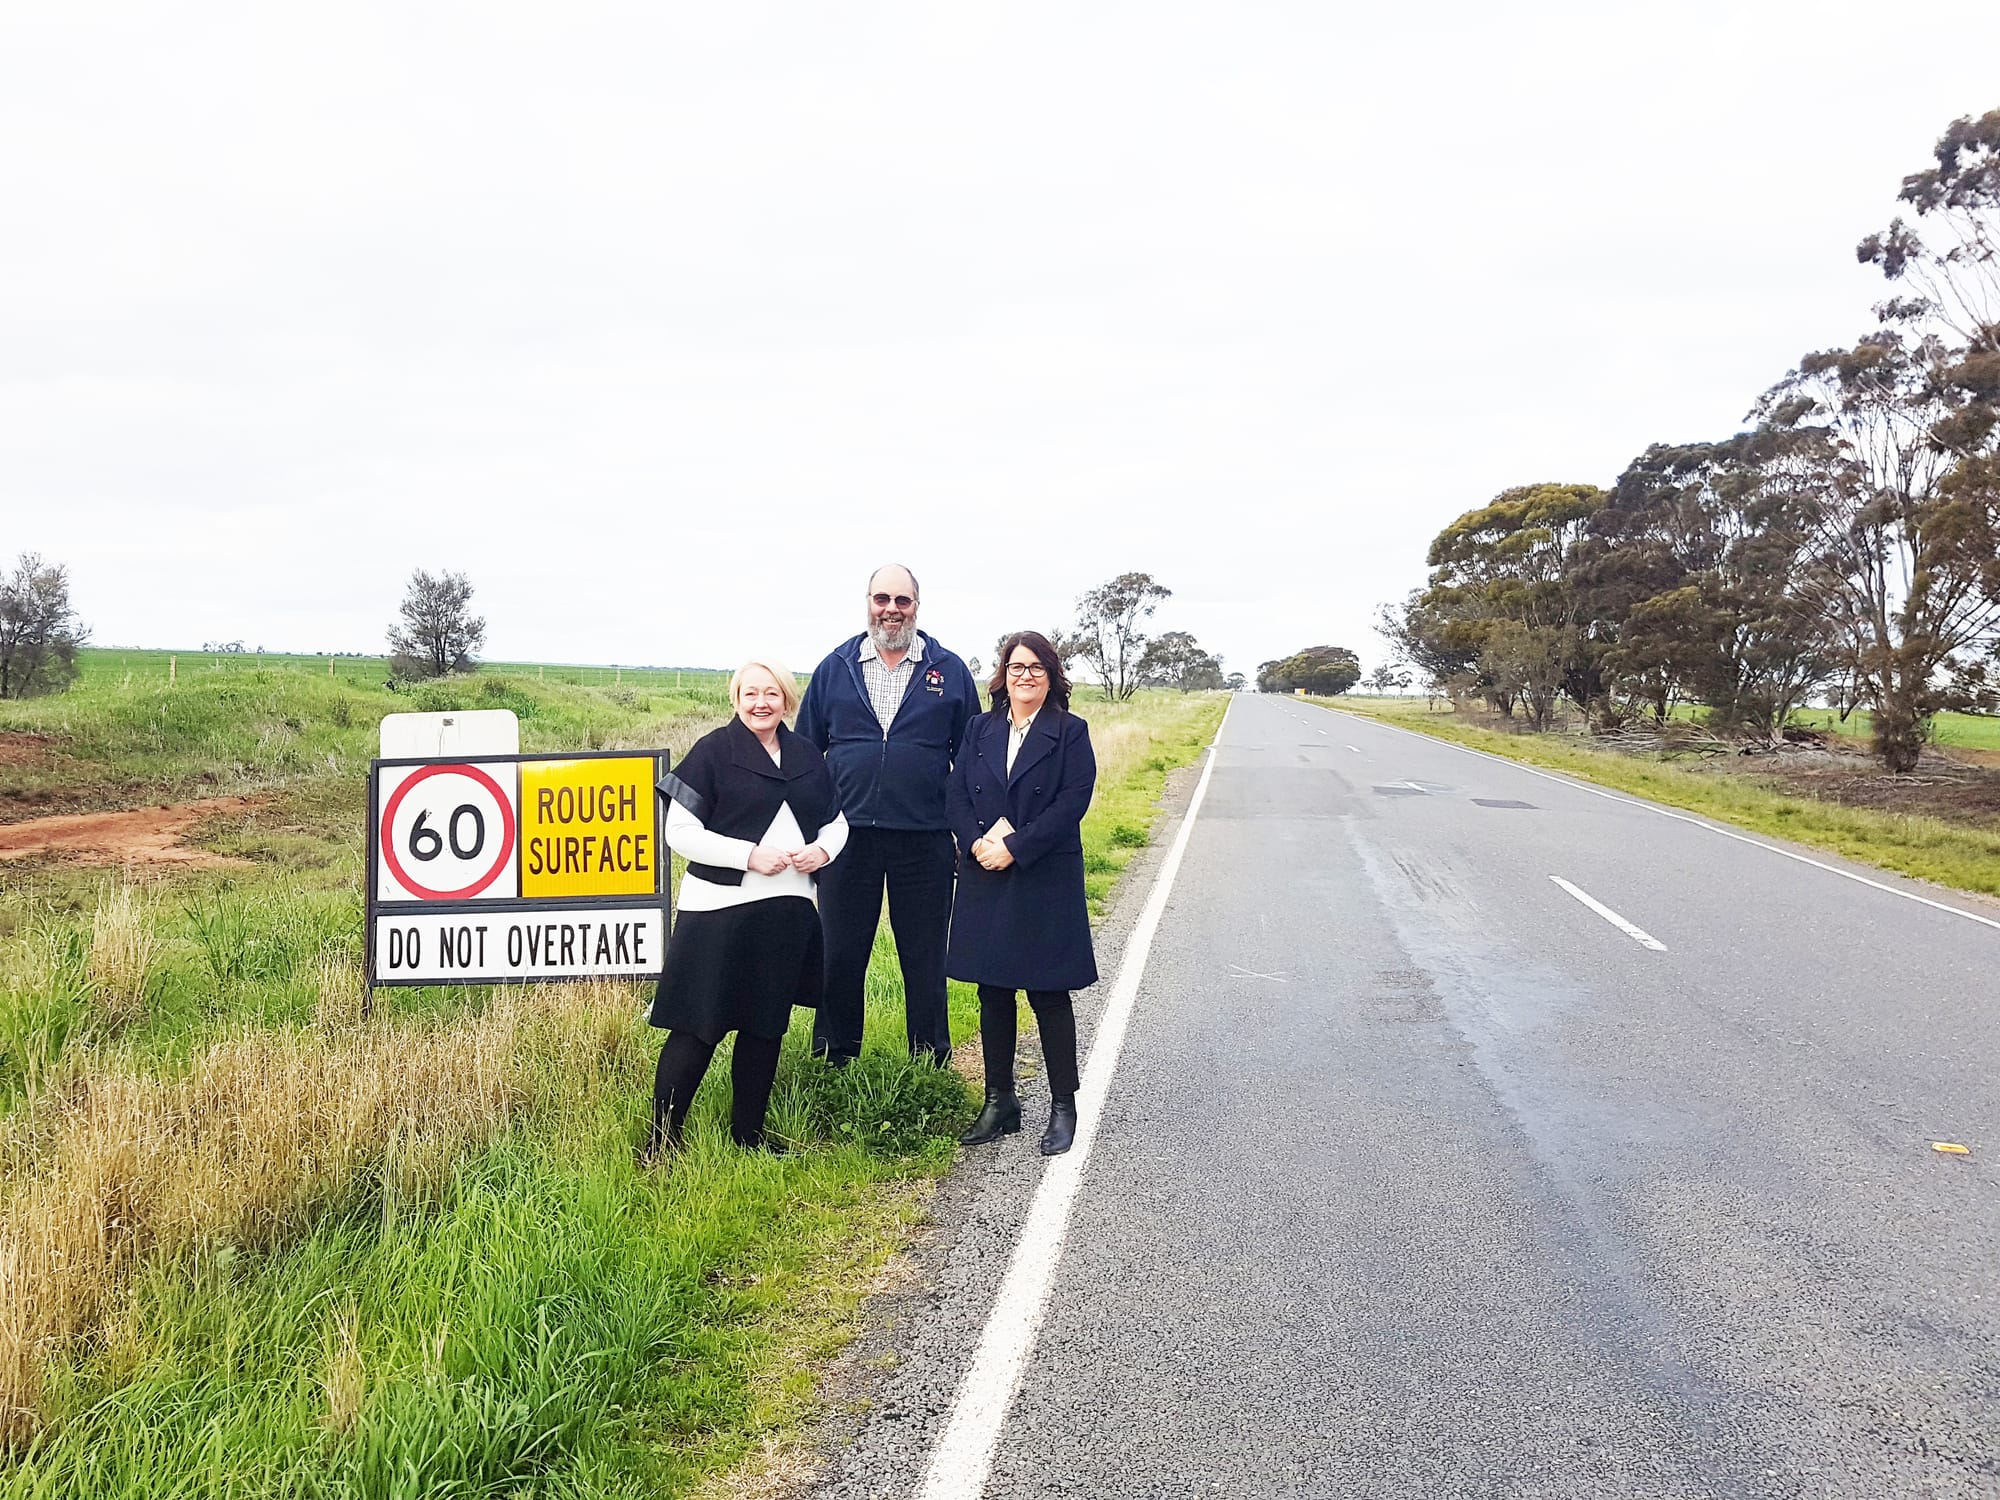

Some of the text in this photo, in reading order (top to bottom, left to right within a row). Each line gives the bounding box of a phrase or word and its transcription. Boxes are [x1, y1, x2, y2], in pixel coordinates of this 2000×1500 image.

[538, 785, 636, 824] ROUGH
[409, 803, 485, 862] 60
[529, 834, 649, 875] SURFACE
[389, 922, 647, 969] DO NOT OVERTAKE
